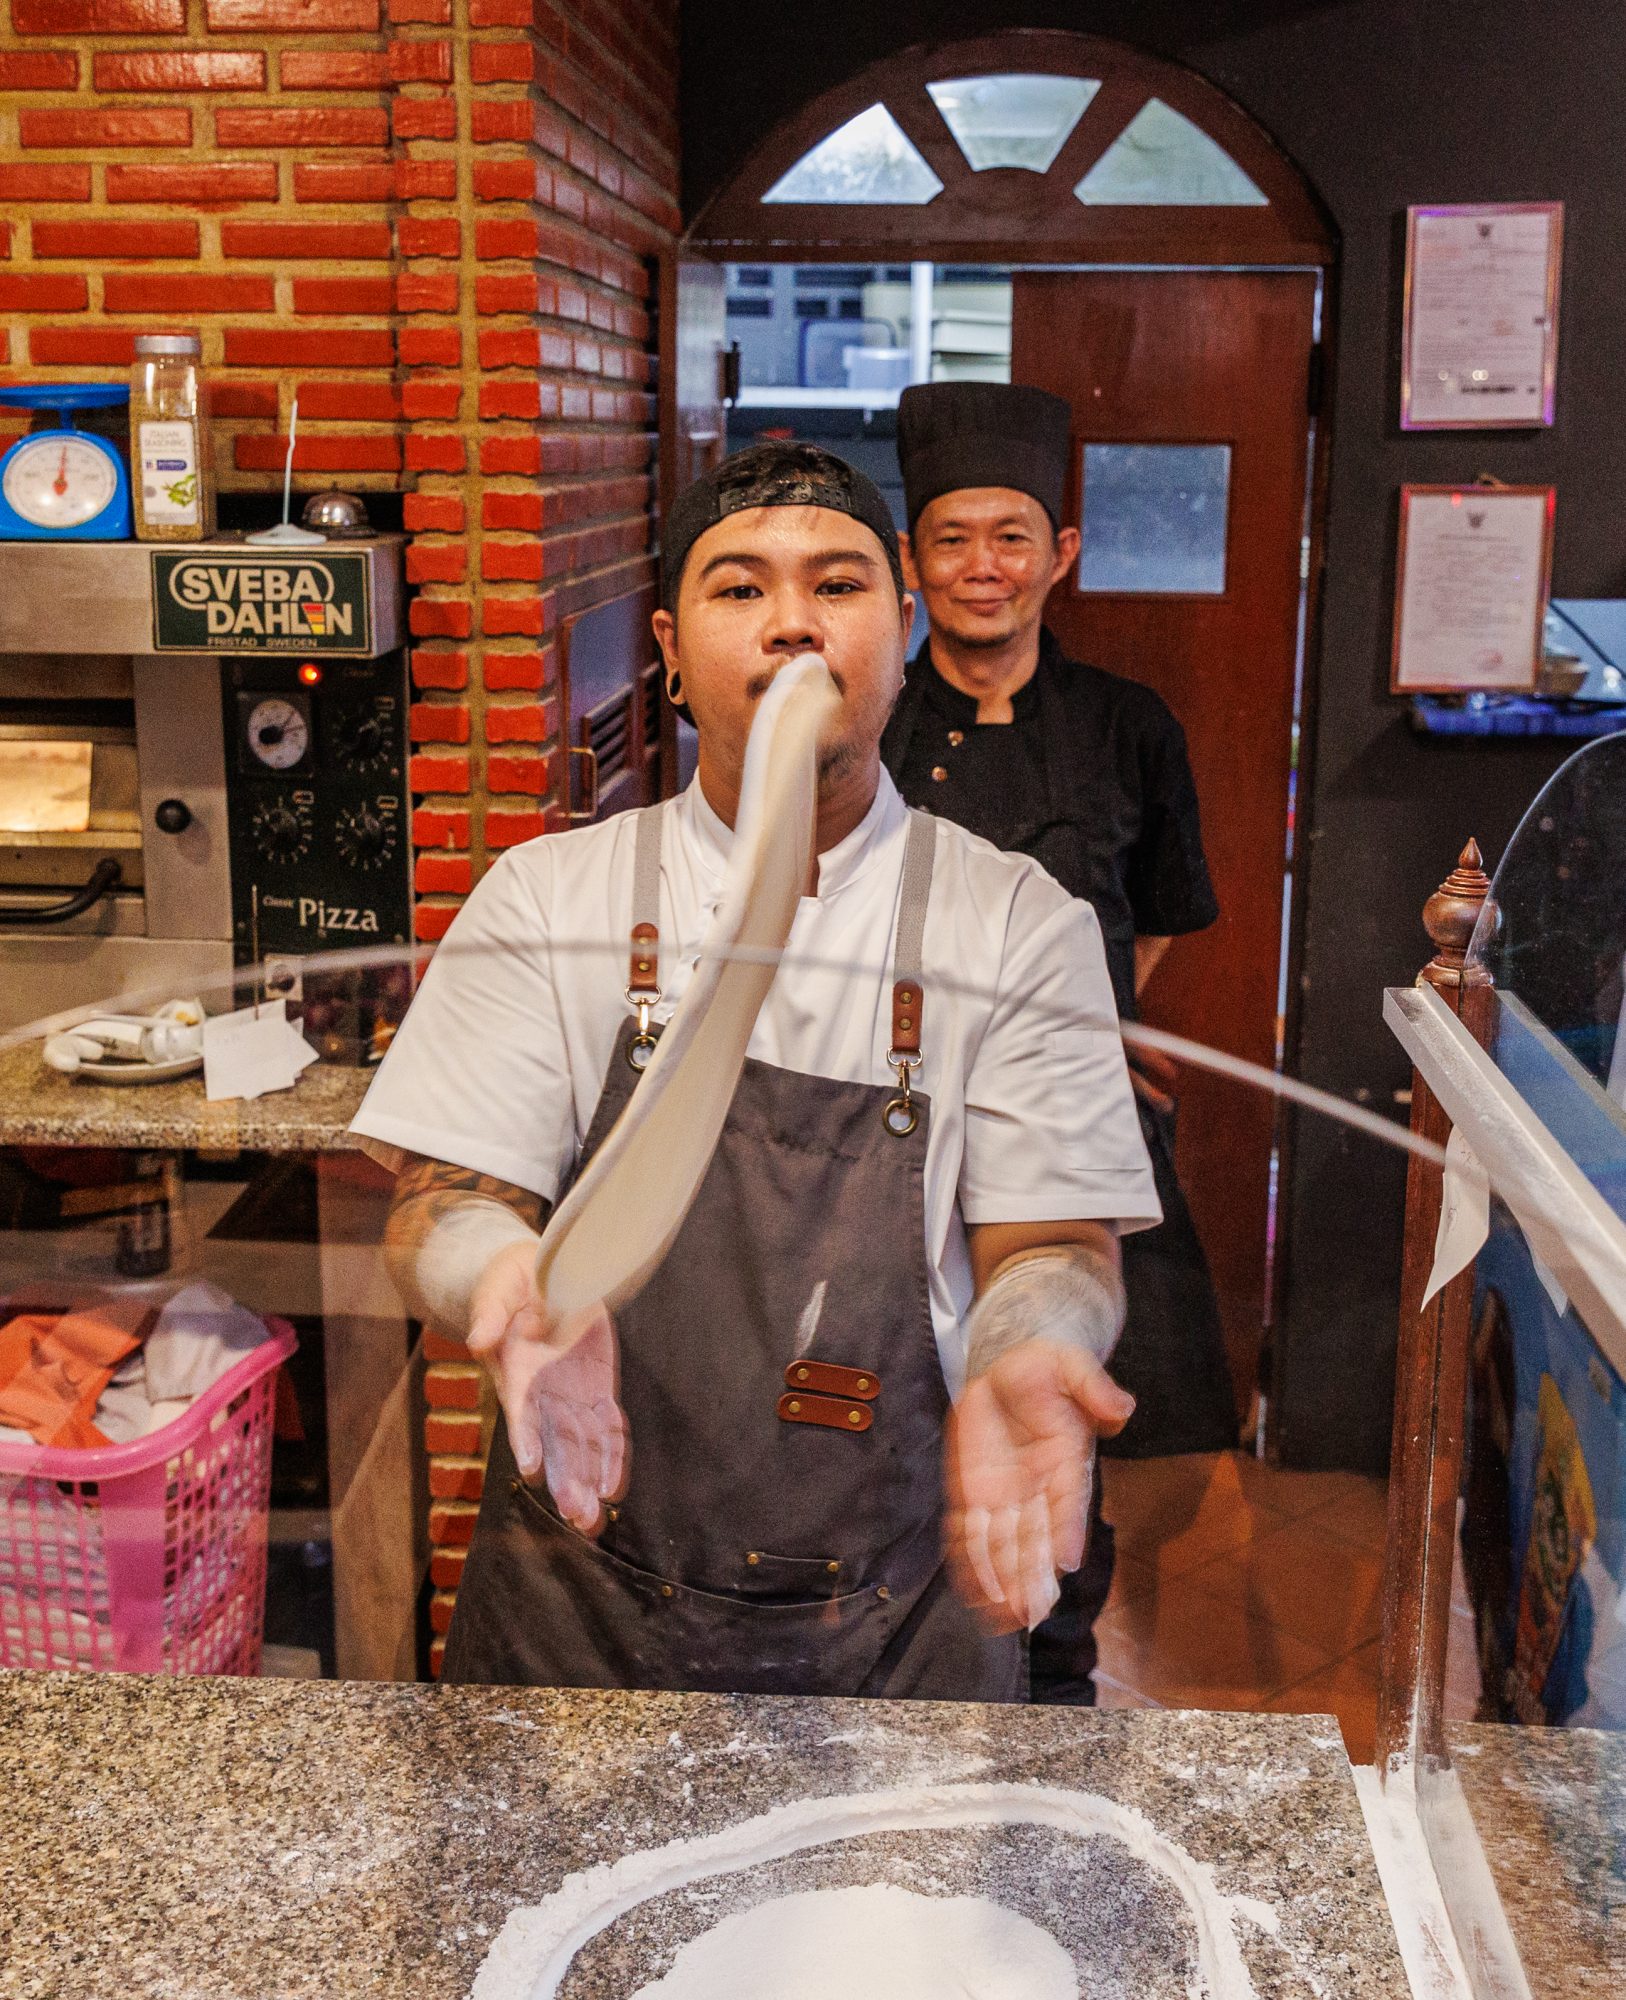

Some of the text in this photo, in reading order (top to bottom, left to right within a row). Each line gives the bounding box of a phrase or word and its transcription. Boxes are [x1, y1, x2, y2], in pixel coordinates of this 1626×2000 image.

[183, 568, 322, 601] SVEBA
[208, 637, 318, 649] FRISTAD SWEDEN
[299, 897, 379, 931] Pizza
